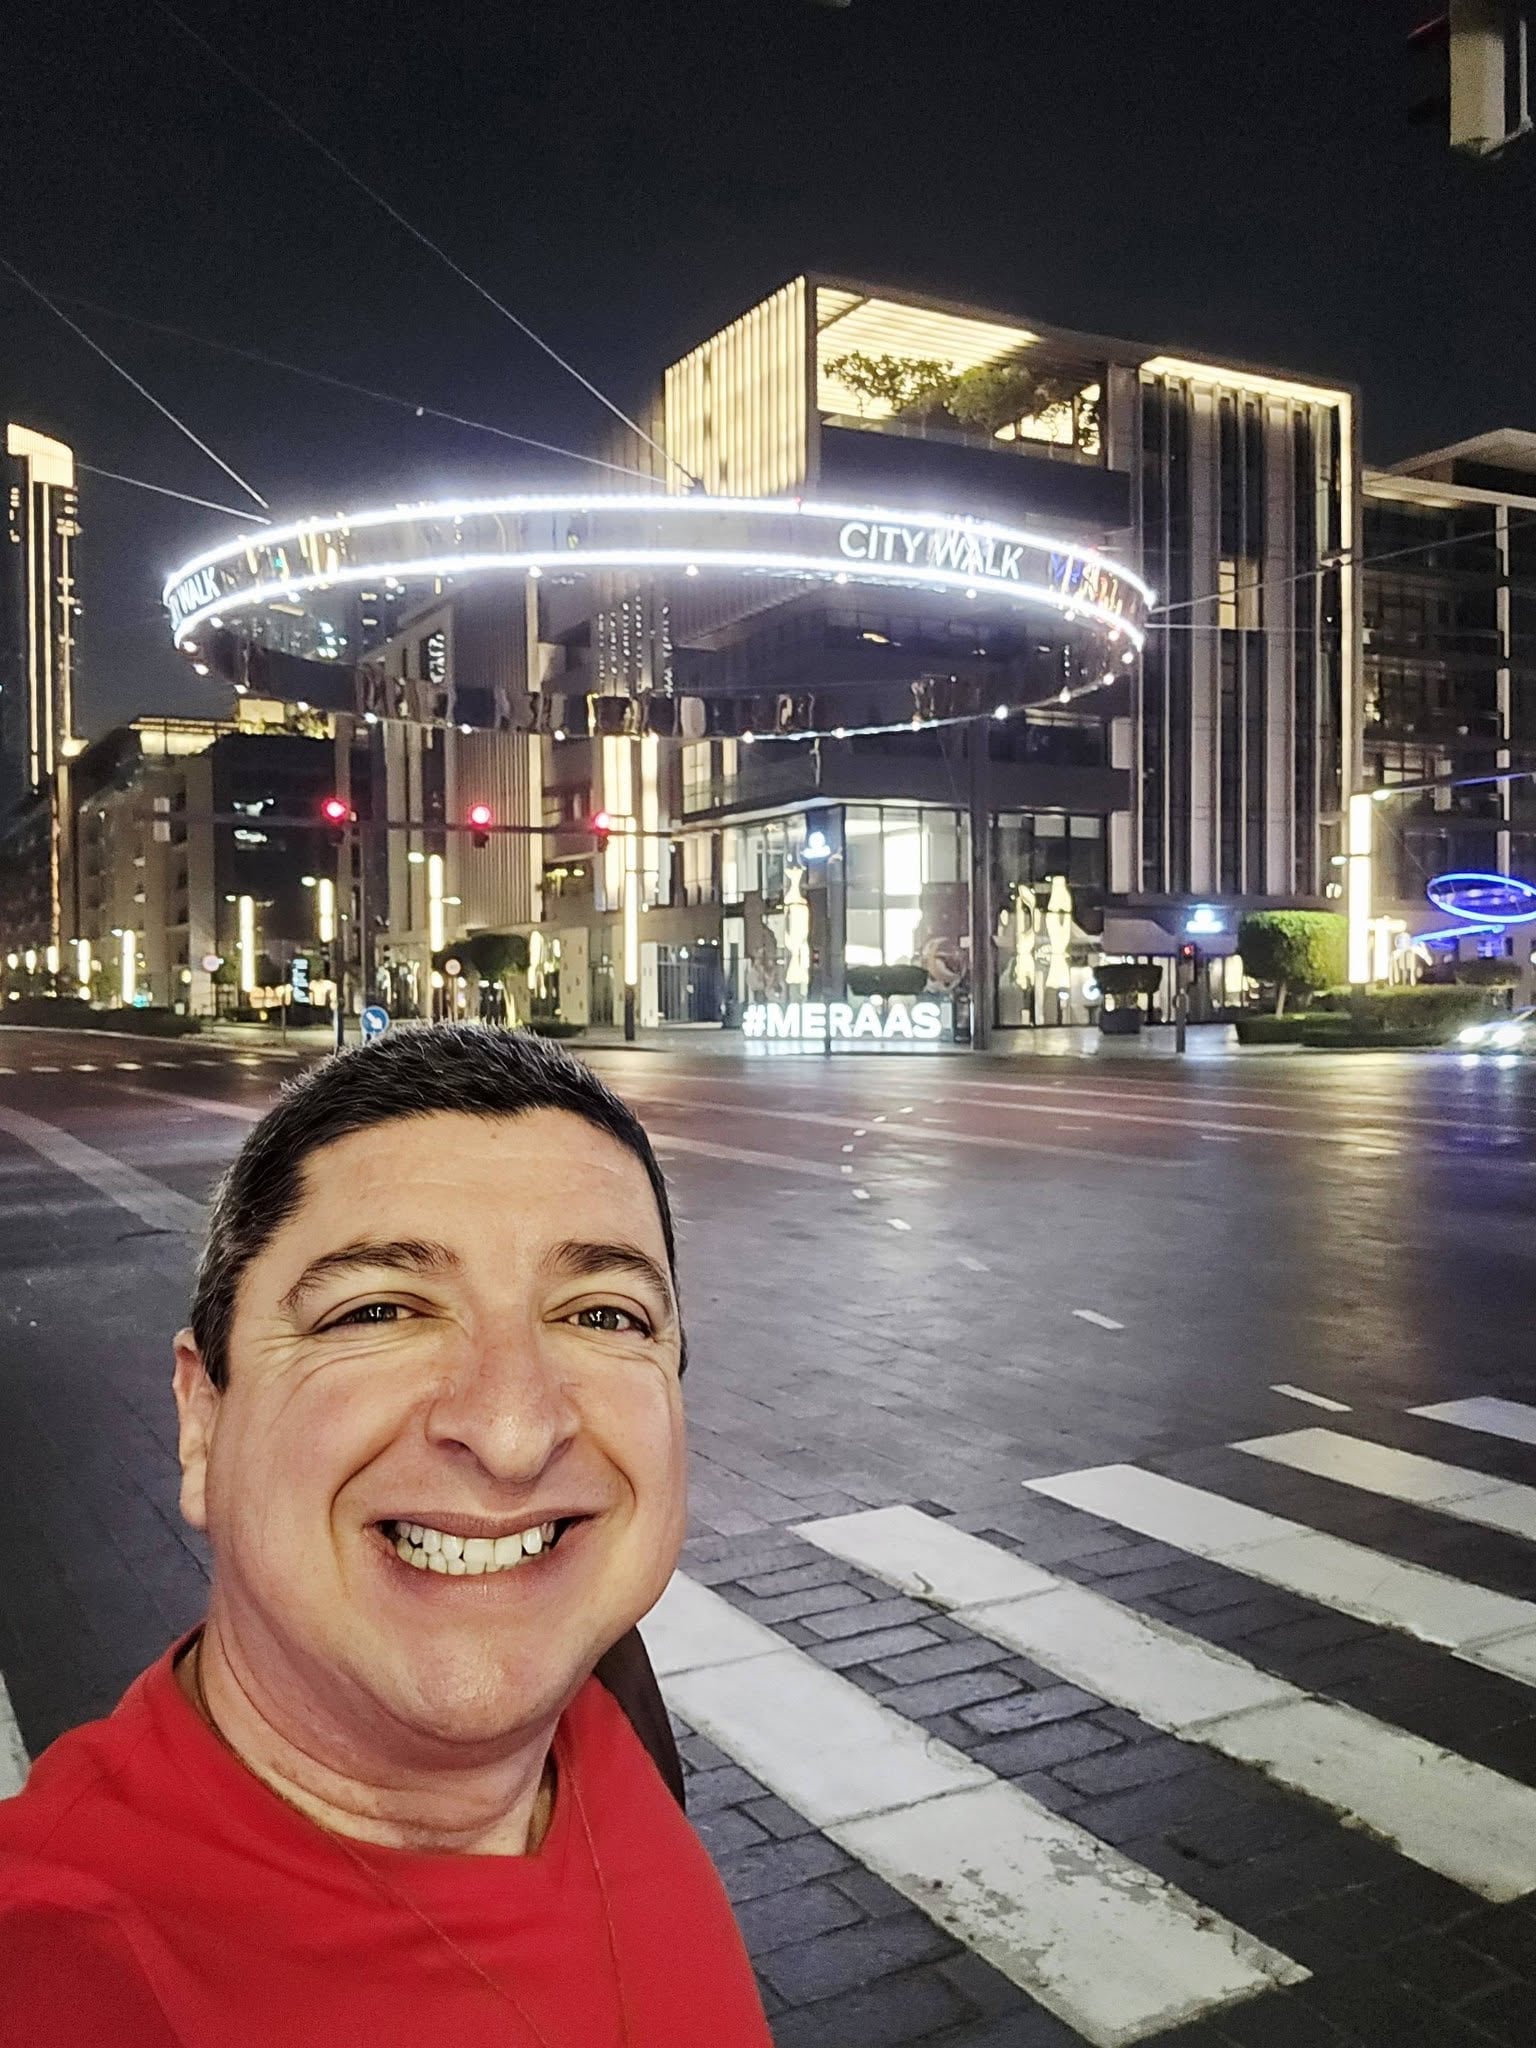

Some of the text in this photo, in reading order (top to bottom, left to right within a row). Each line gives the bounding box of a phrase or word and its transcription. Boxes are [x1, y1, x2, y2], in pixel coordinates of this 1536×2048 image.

[839, 521, 1024, 580] CITY WALK
[176, 566, 221, 615] WALK
[742, 1002, 942, 1039] #MERAAS
